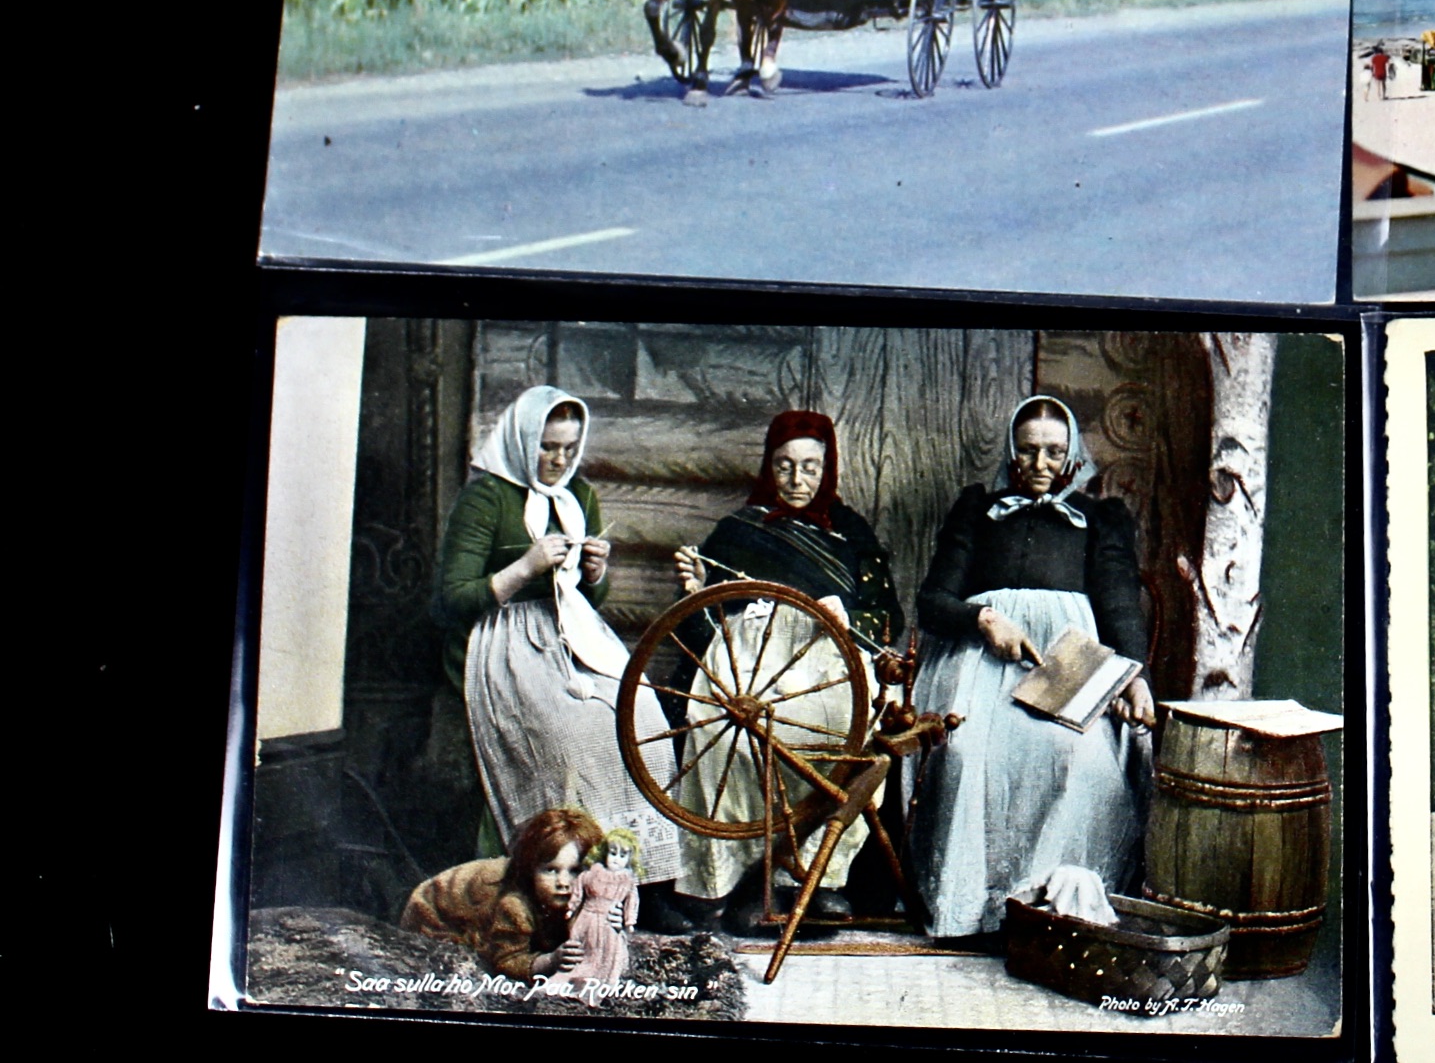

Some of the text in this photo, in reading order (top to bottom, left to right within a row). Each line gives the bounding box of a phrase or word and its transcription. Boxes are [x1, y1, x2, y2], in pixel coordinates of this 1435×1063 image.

[471, 974, 525, 998] Mor
[578, 978, 659, 1007] Rokken
[1099, 995, 1141, 1011] Photo
[1144, 997, 1161, 1015] by
[1196, 998, 1246, 1017] Hagen
